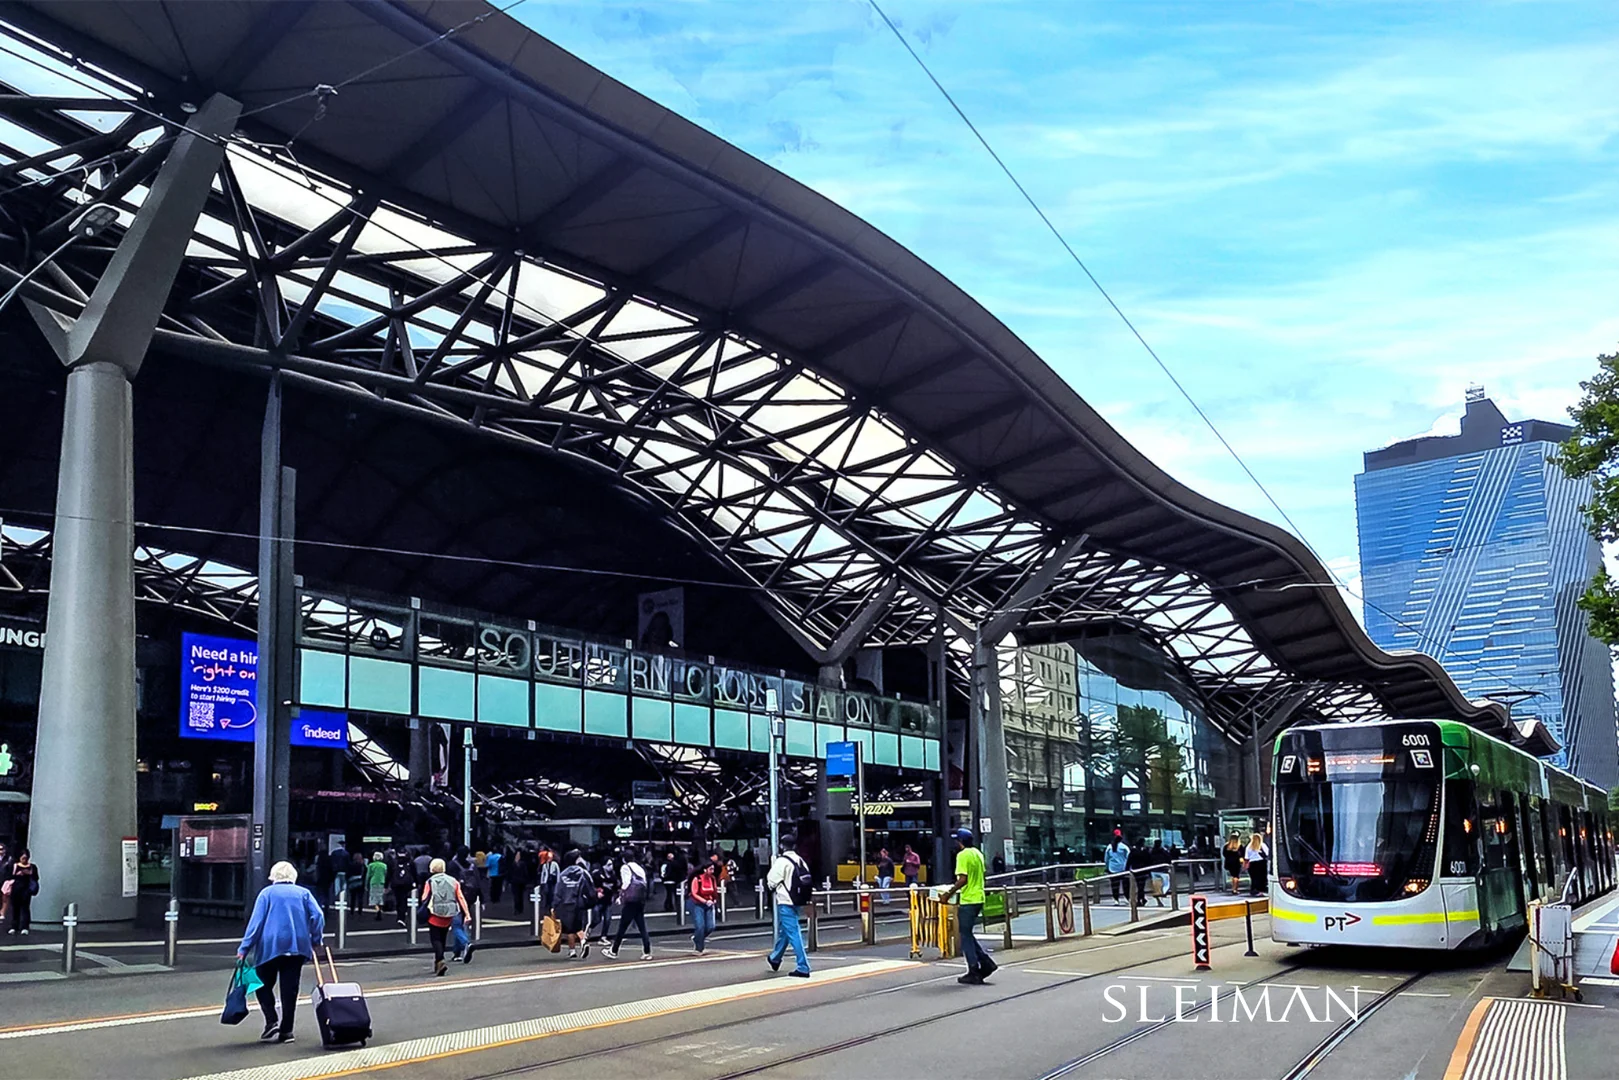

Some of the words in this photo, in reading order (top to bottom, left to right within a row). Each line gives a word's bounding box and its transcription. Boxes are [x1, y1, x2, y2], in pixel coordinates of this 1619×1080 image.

[191, 645, 228, 662] Need
[229, 652, 238, 663] a
[191, 662, 236, 682] right
[239, 670, 256, 681] on
[480, 628, 671, 693] SOUTHERN
[687, 665, 770, 707] CROSS
[190, 684, 212, 693] Here's
[212, 685, 231, 695] $200
[231, 687, 250, 697] credit
[199, 694, 215, 702] start
[215, 694, 236, 704] hiring
[301, 724, 341, 740] indeed
[1402, 734, 1430, 746] 6001
